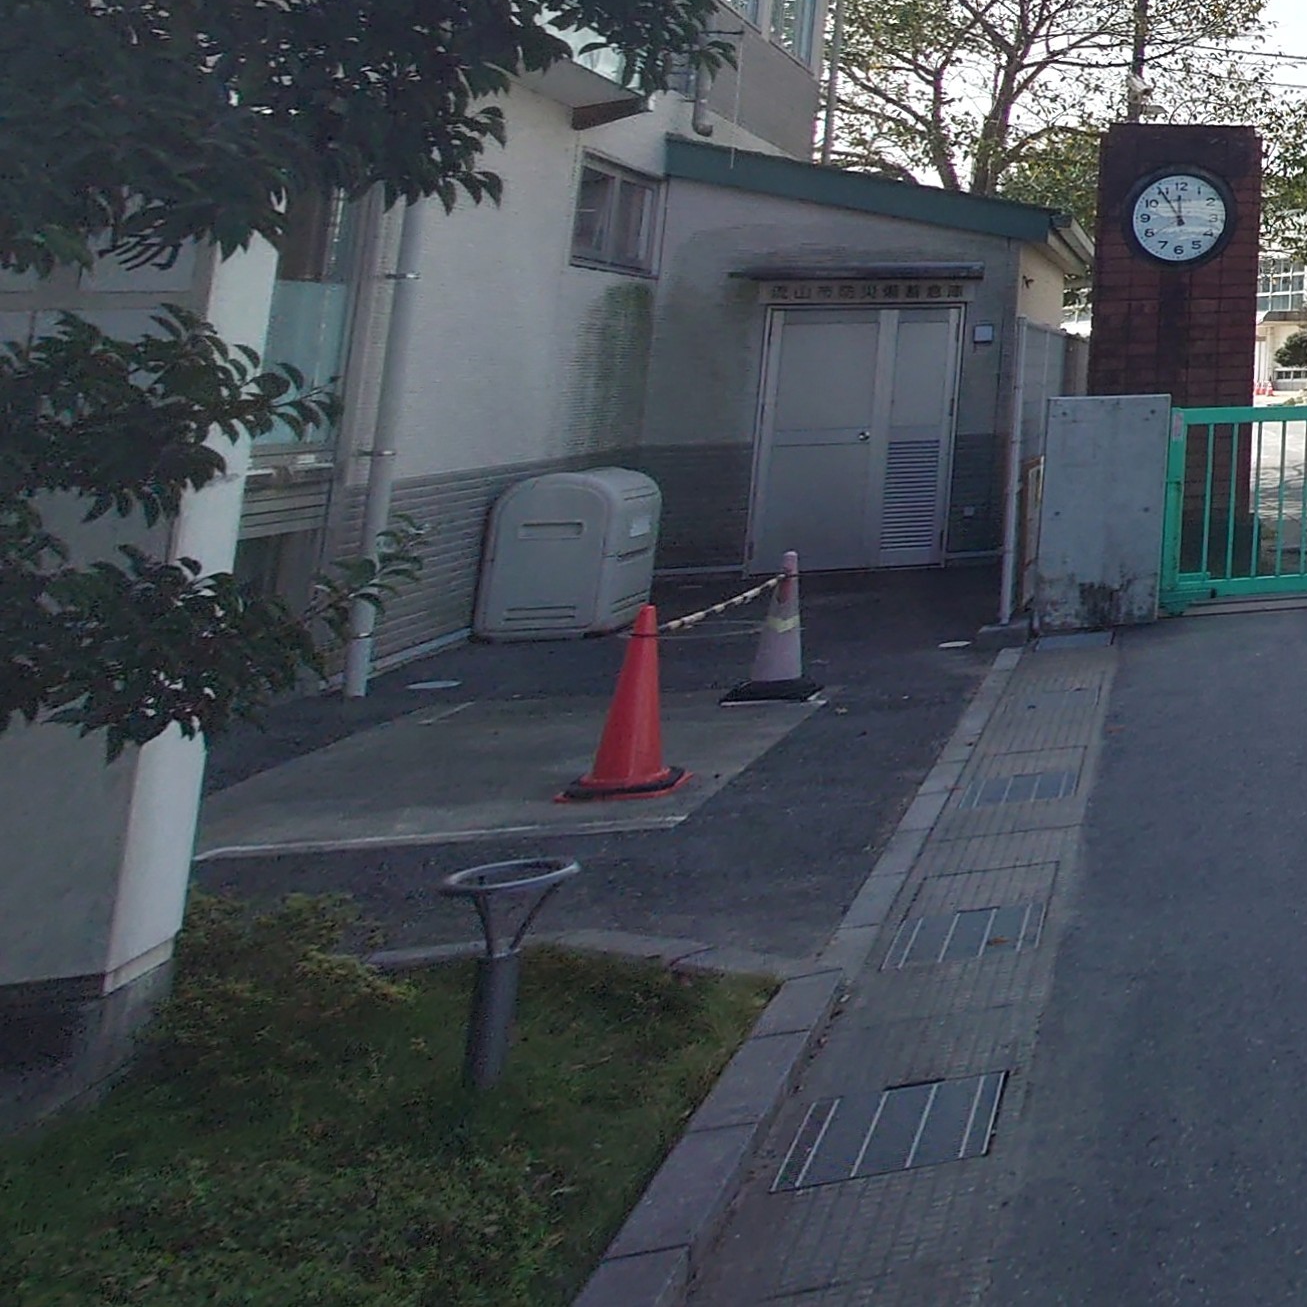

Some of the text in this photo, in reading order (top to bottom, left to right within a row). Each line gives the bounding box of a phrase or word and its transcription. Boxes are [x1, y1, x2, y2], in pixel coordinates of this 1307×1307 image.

[1175, 182, 1188, 191] 12
[1197, 187, 1201, 195] 1
[1145, 199, 1159, 208] 10
[1206, 197, 1216, 207] 2
[1140, 213, 1150, 223] 9
[1209, 213, 1218, 223] 3
[1144, 229, 1154, 238] 8
[1203, 229, 1214, 237] 4
[1158, 240, 1168, 249] 7
[1192, 240, 1201, 249] 5
[1174, 245, 1184, 254] 6
